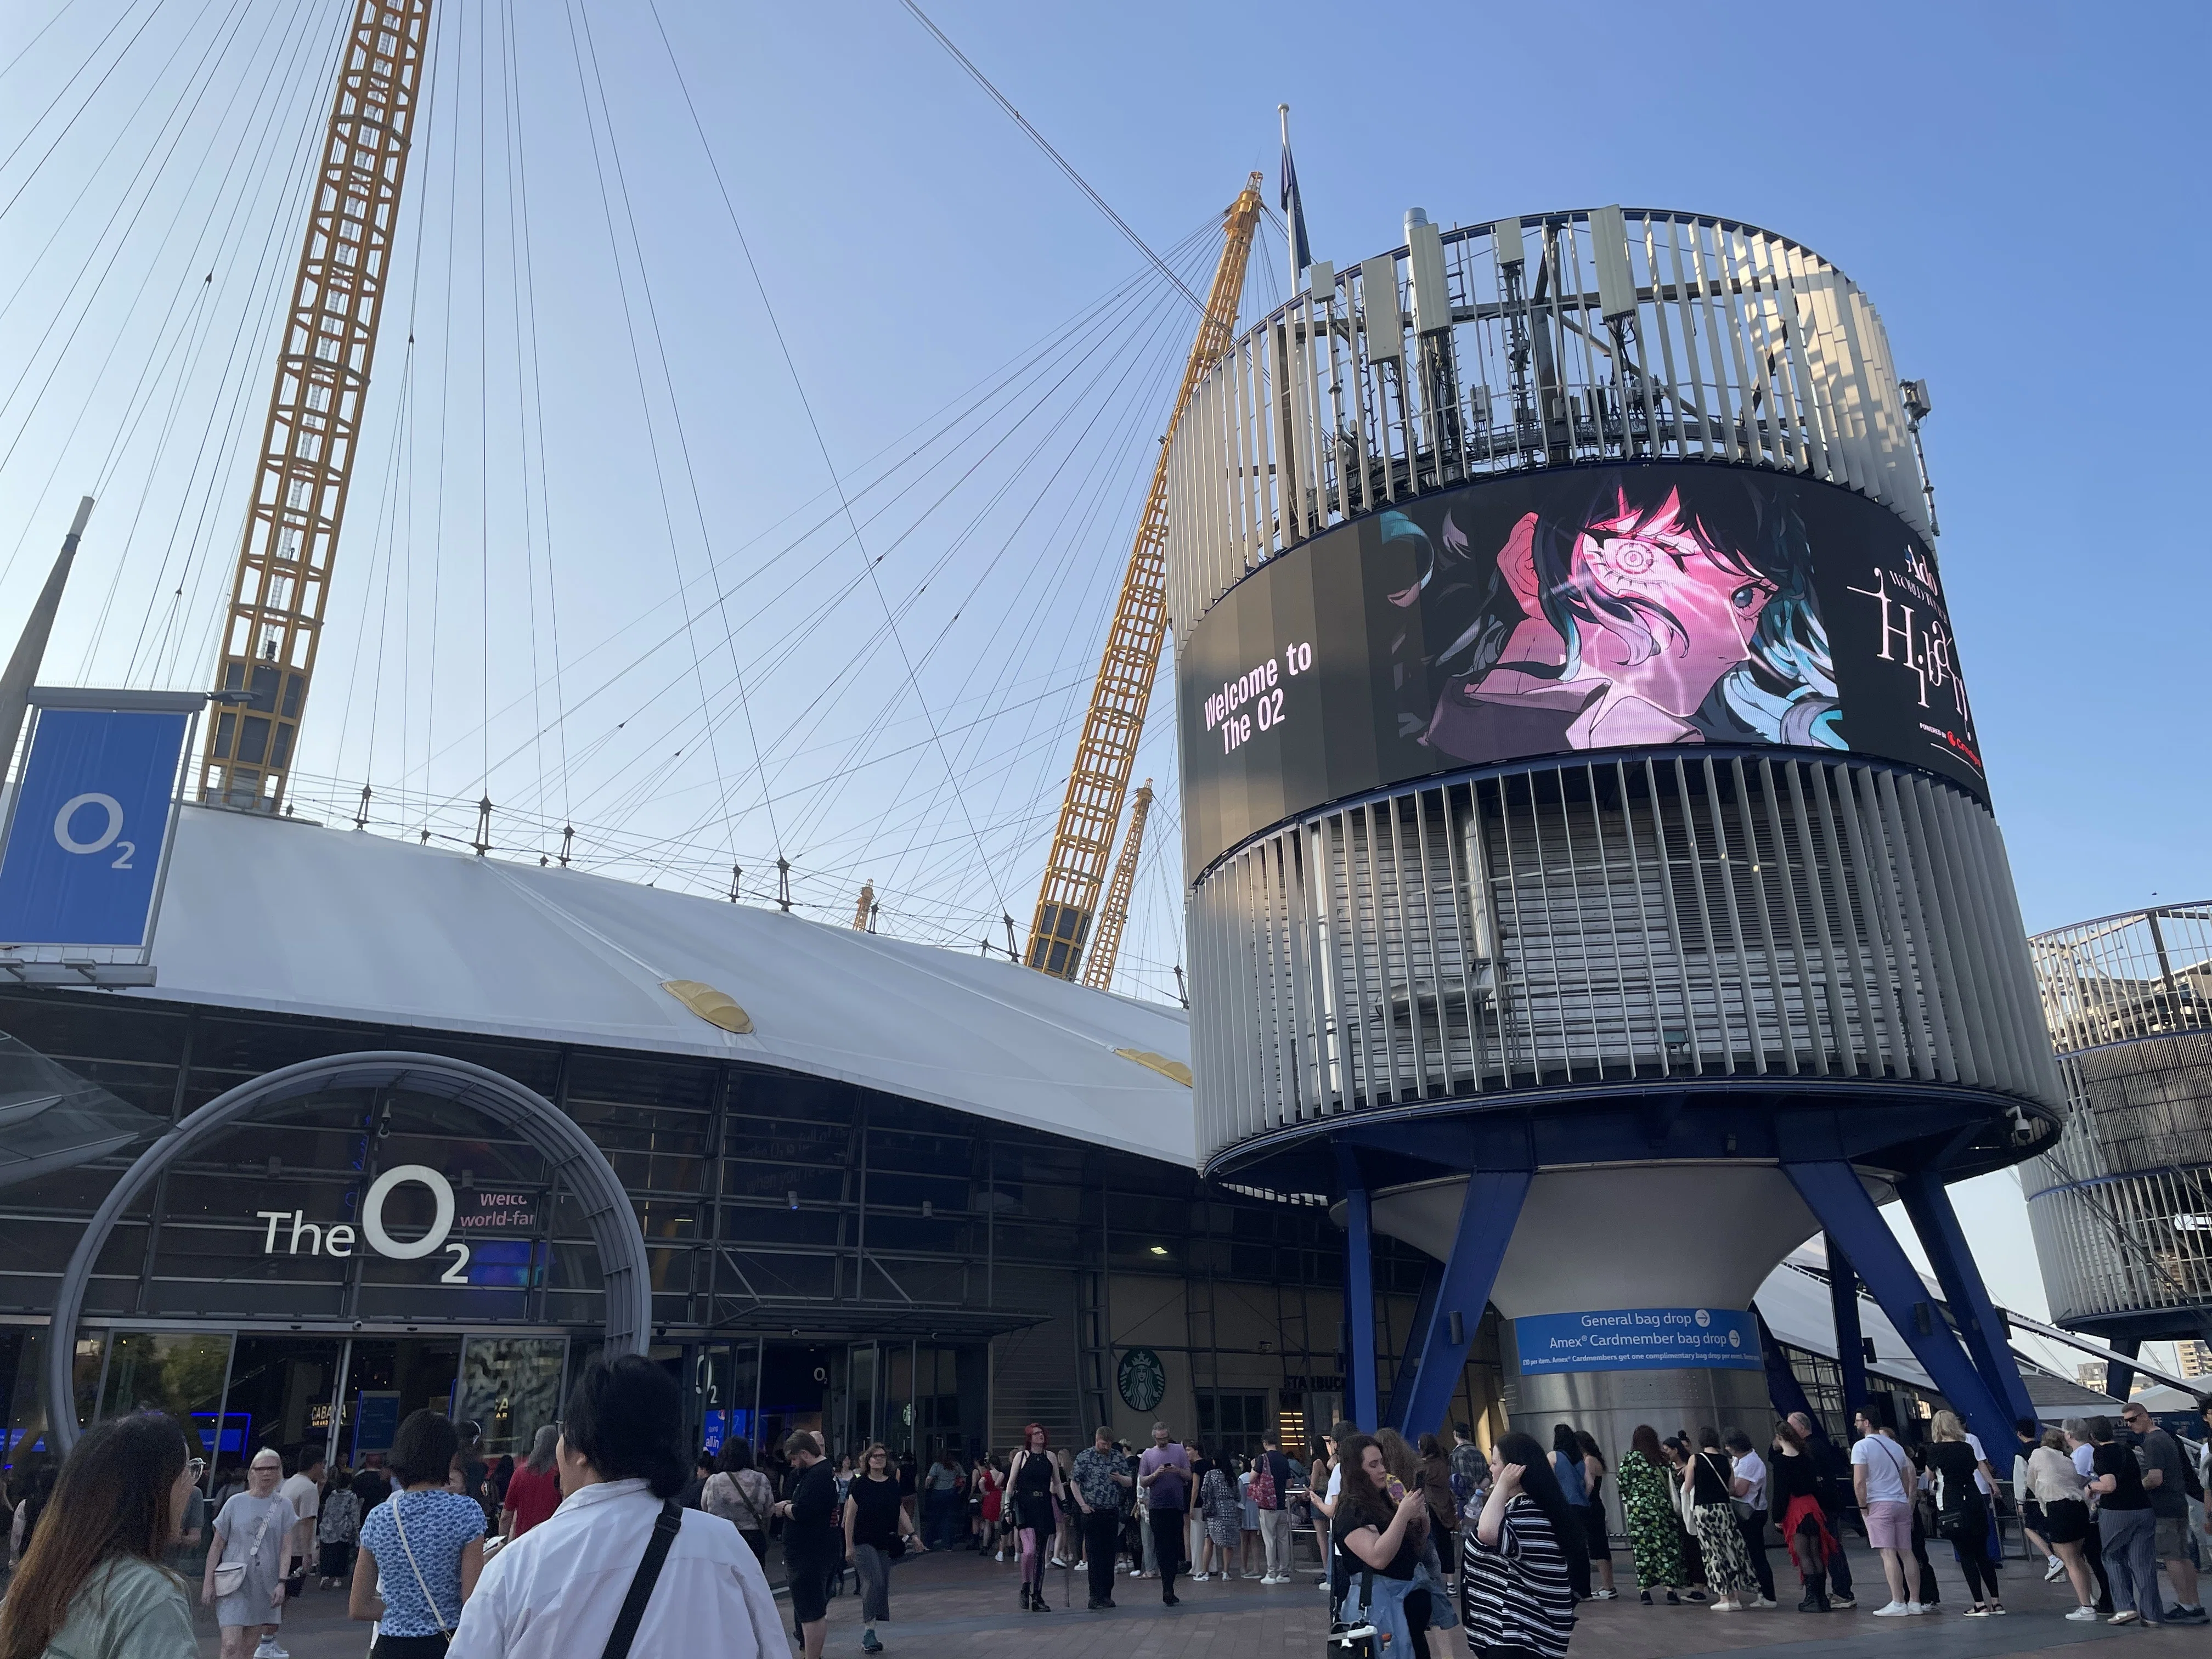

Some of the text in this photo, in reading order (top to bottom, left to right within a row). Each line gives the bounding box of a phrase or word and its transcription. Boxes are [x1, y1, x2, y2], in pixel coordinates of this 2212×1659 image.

[1904, 544, 1938, 596] Ado
[1204, 642, 1312, 732] Welcome to
[1221, 713, 1251, 755] The
[54, 792, 136, 869] O2
[256, 1164, 470, 1284] The O2
[1581, 1312, 1692, 1328] General bag drop
[1590, 1333, 1674, 1346] Cardmember
[1677, 1332, 1701, 1347] bag
[1703, 1331, 1727, 1347] drop
[1645, 1352, 1695, 1361] complimentary
[1696, 1352, 1707, 1361] bag
[1708, 1352, 1721, 1360] drop
[814, 1367, 828, 1384] O2
[1285, 1375, 1346, 1391] STARBUC
